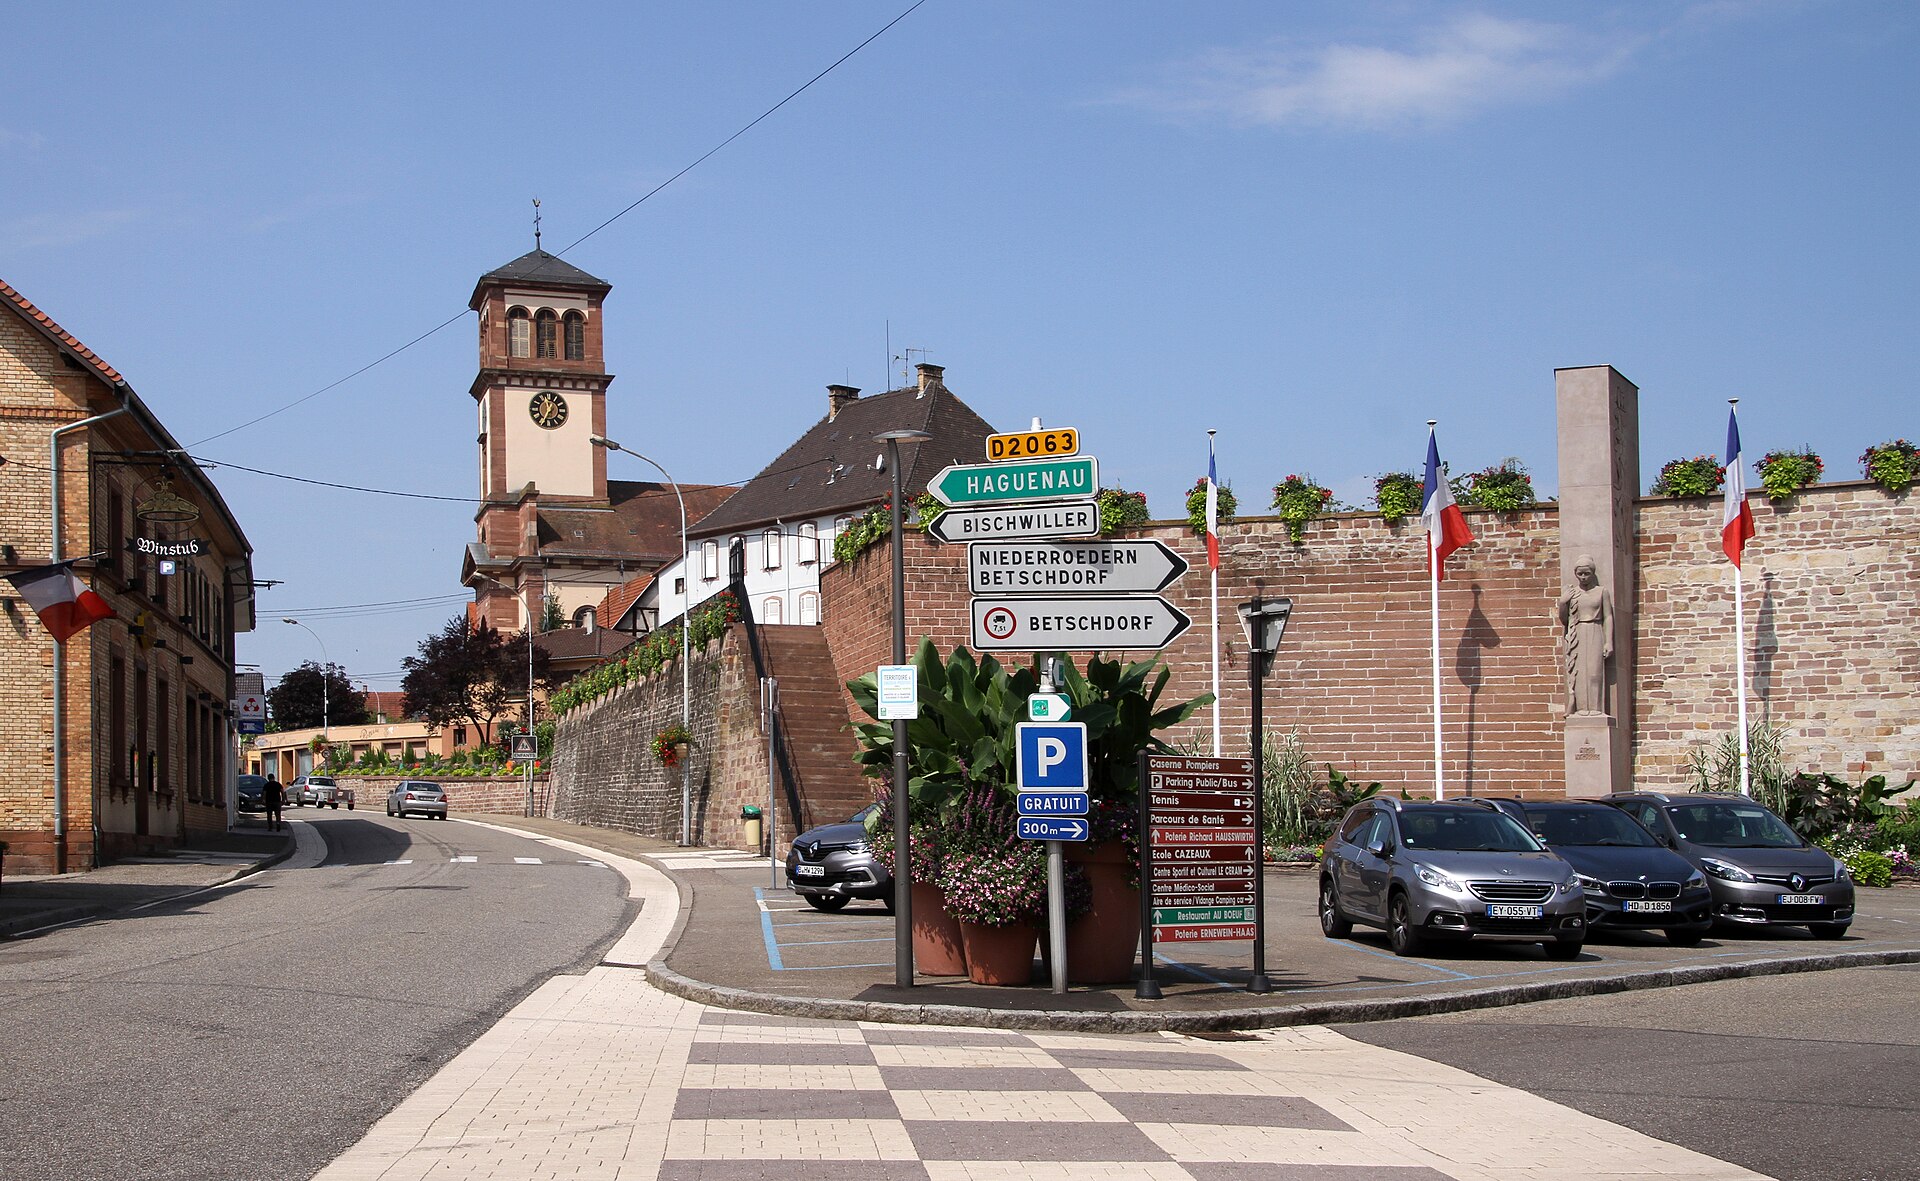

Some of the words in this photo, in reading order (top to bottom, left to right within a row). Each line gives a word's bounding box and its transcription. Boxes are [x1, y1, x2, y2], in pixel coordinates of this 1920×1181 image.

[991, 433, 1073, 457] D2063
[967, 469, 1085, 494] HAGUENAU
[963, 512, 1088, 533] BISCHWILLER
[136, 537, 199, 556] Winstub
[979, 549, 1137, 566] NIEDERROEDERN
[162, 562, 173, 573] P
[980, 570, 1109, 586] BETSCHDORF
[1029, 616, 1154, 631] BETSCHDORF
[1037, 737, 1067, 777] P
[1149, 758, 1183, 769] Caserne
[1185, 760, 1220, 771] Pompiers
[1165, 777, 1193, 788] Parking
[1195, 777, 1238, 788] Public/Bus
[1024, 797, 1081, 810] GRATUIT
[1151, 795, 1180, 805] Tennis
[1150, 813, 1185, 824] Parcours
[1188, 814, 1199, 824] de
[1202, 814, 1225, 825] Santé
[1165, 832, 1187, 841] Poterie
[1189, 832, 1213, 841] Richard
[1215, 832, 1254, 841] HAUSSWIRTH
[1152, 849, 1172, 859] Ecole
[1174, 849, 1211, 859] CAZEAUX
[1153, 867, 1171, 877] Centre
[1172, 867, 1189, 878] Sportif
[1190, 867, 1196, 876] et
[1197, 866, 1217, 876] Culturel
[1218, 866, 1224, 876] LE
[1224, 866, 1243, 876] CERAM
[1152, 883, 1172, 892] Centre
[1173, 883, 1215, 892] Médico-Social
[1152, 897, 1164, 906] Aire
[1164, 896, 1173, 905] de
[1215, 896, 1236, 906] Camping
[1628, 901, 1639, 910] HD
[1651, 902, 1671, 910] 1856
[1177, 911, 1211, 920] Restaurant
[1213, 911, 1222, 920] AU
[1223, 910, 1243, 919] BOEUF
[1174, 929, 1198, 939] Poterie
[1200, 927, 1255, 938] ERNEWEIN-HAAS
